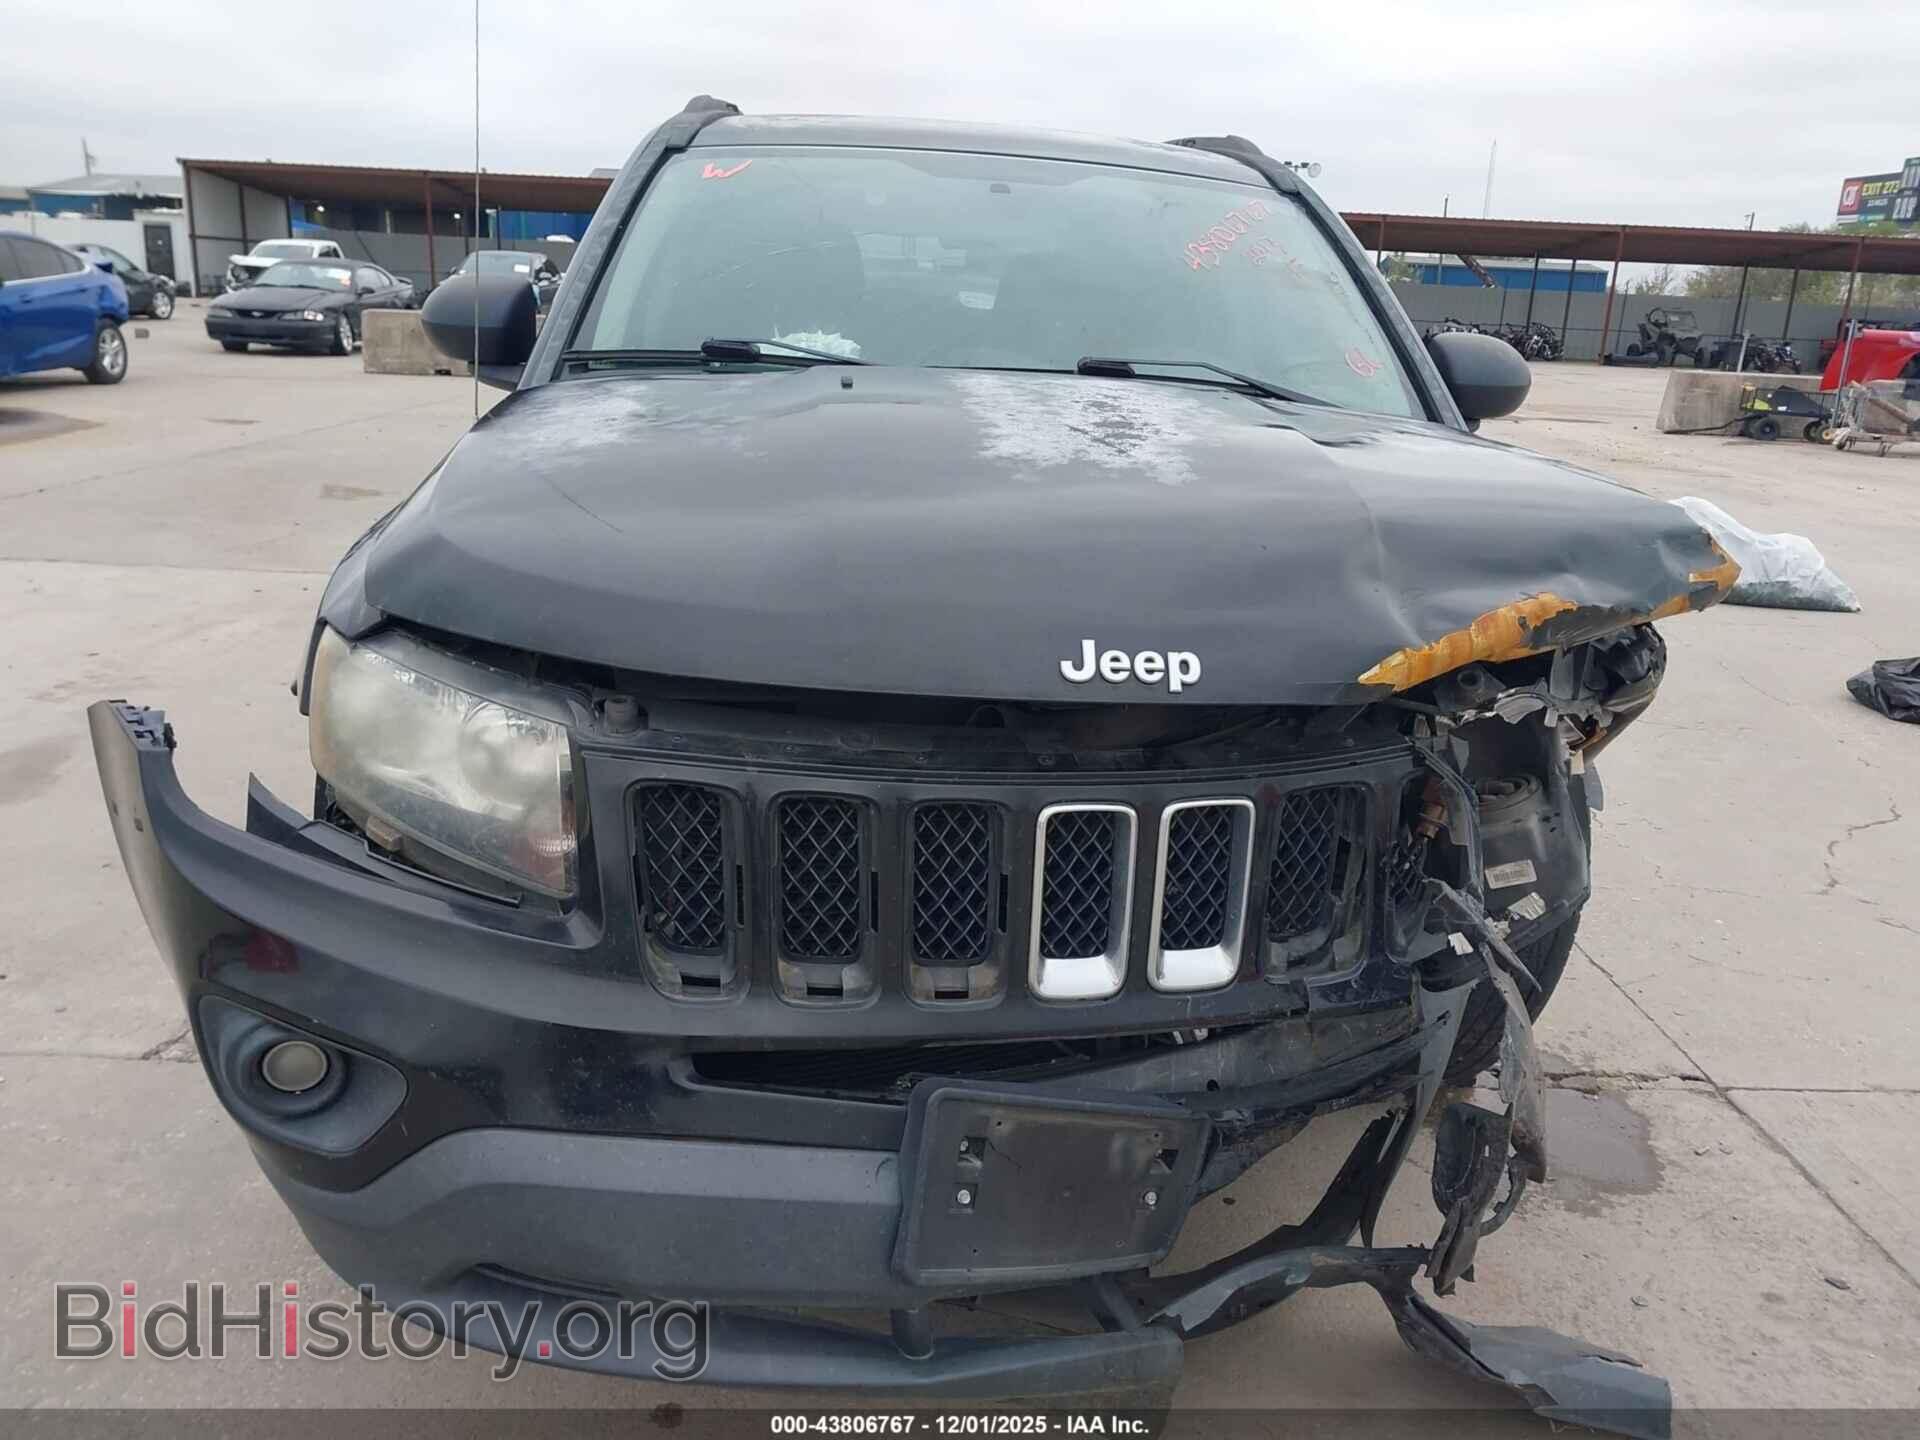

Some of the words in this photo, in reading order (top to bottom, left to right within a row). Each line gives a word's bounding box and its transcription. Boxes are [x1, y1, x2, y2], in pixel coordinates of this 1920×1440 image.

[1861, 182, 1882, 196] EXIT
[1883, 180, 1901, 193] 273
[1060, 639, 1201, 693] Jeep
